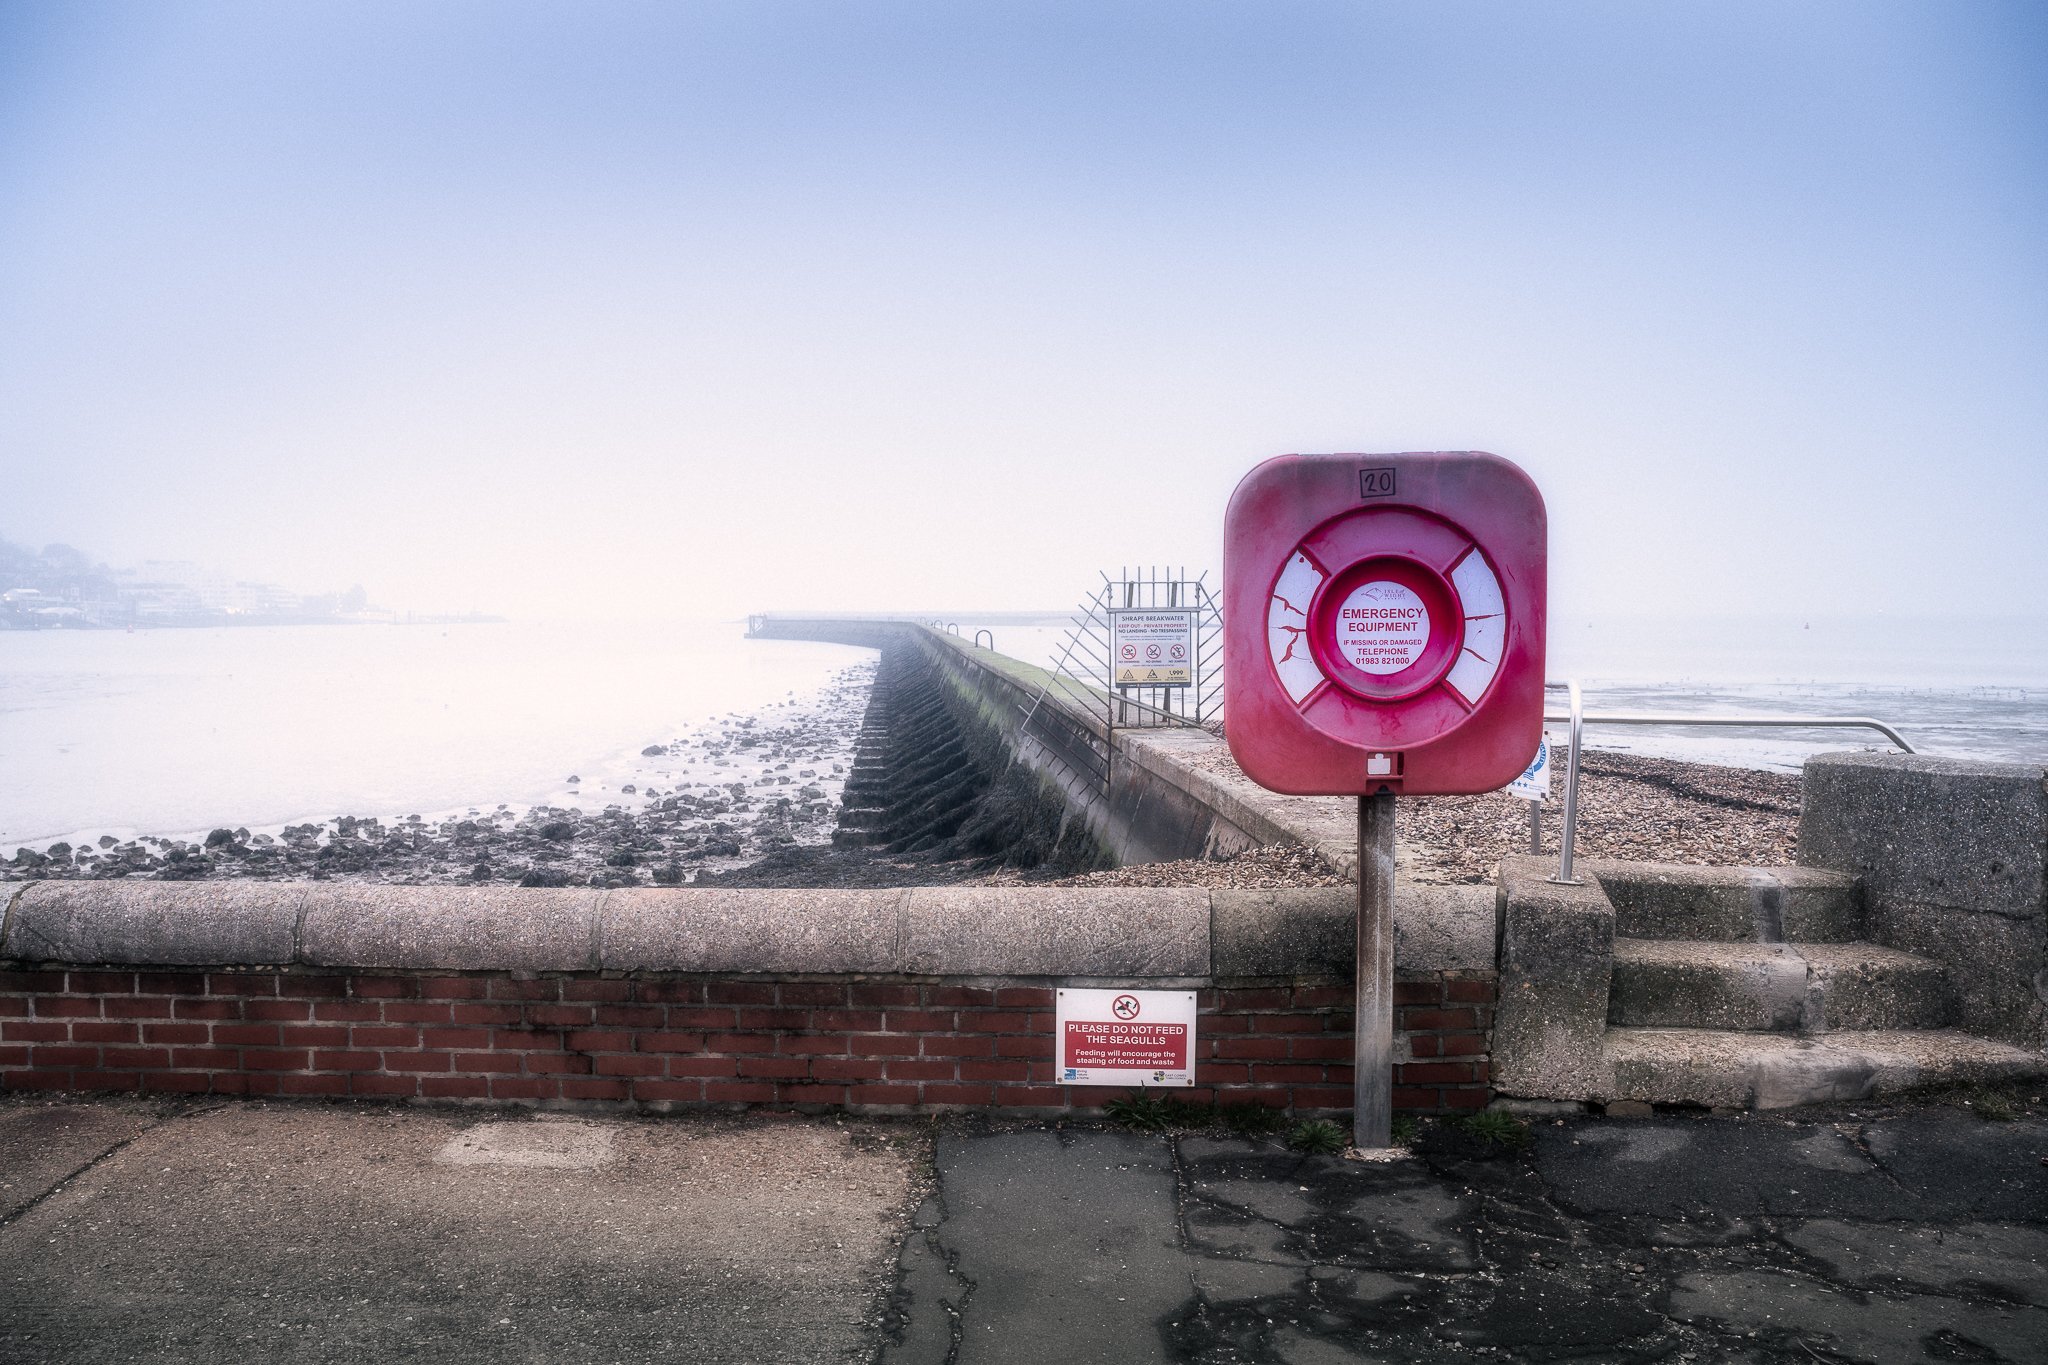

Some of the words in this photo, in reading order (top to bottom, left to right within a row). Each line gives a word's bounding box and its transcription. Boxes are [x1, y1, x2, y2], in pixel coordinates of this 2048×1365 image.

[1365, 473, 1391, 491] 20
[1342, 608, 1424, 619] EMERGENCY
[1348, 622, 1418, 632] EQUIPMENT
[1068, 1024, 1110, 1033] PLEASE
[1112, 1025, 1128, 1034] DO
[1131, 1026, 1153, 1034] NOT
[1156, 1026, 1184, 1035] FEED
[1086, 1035, 1106, 1044] THE
[1110, 1036, 1166, 1044] SEAGULLS
[1075, 1049, 1106, 1057] Feeding
